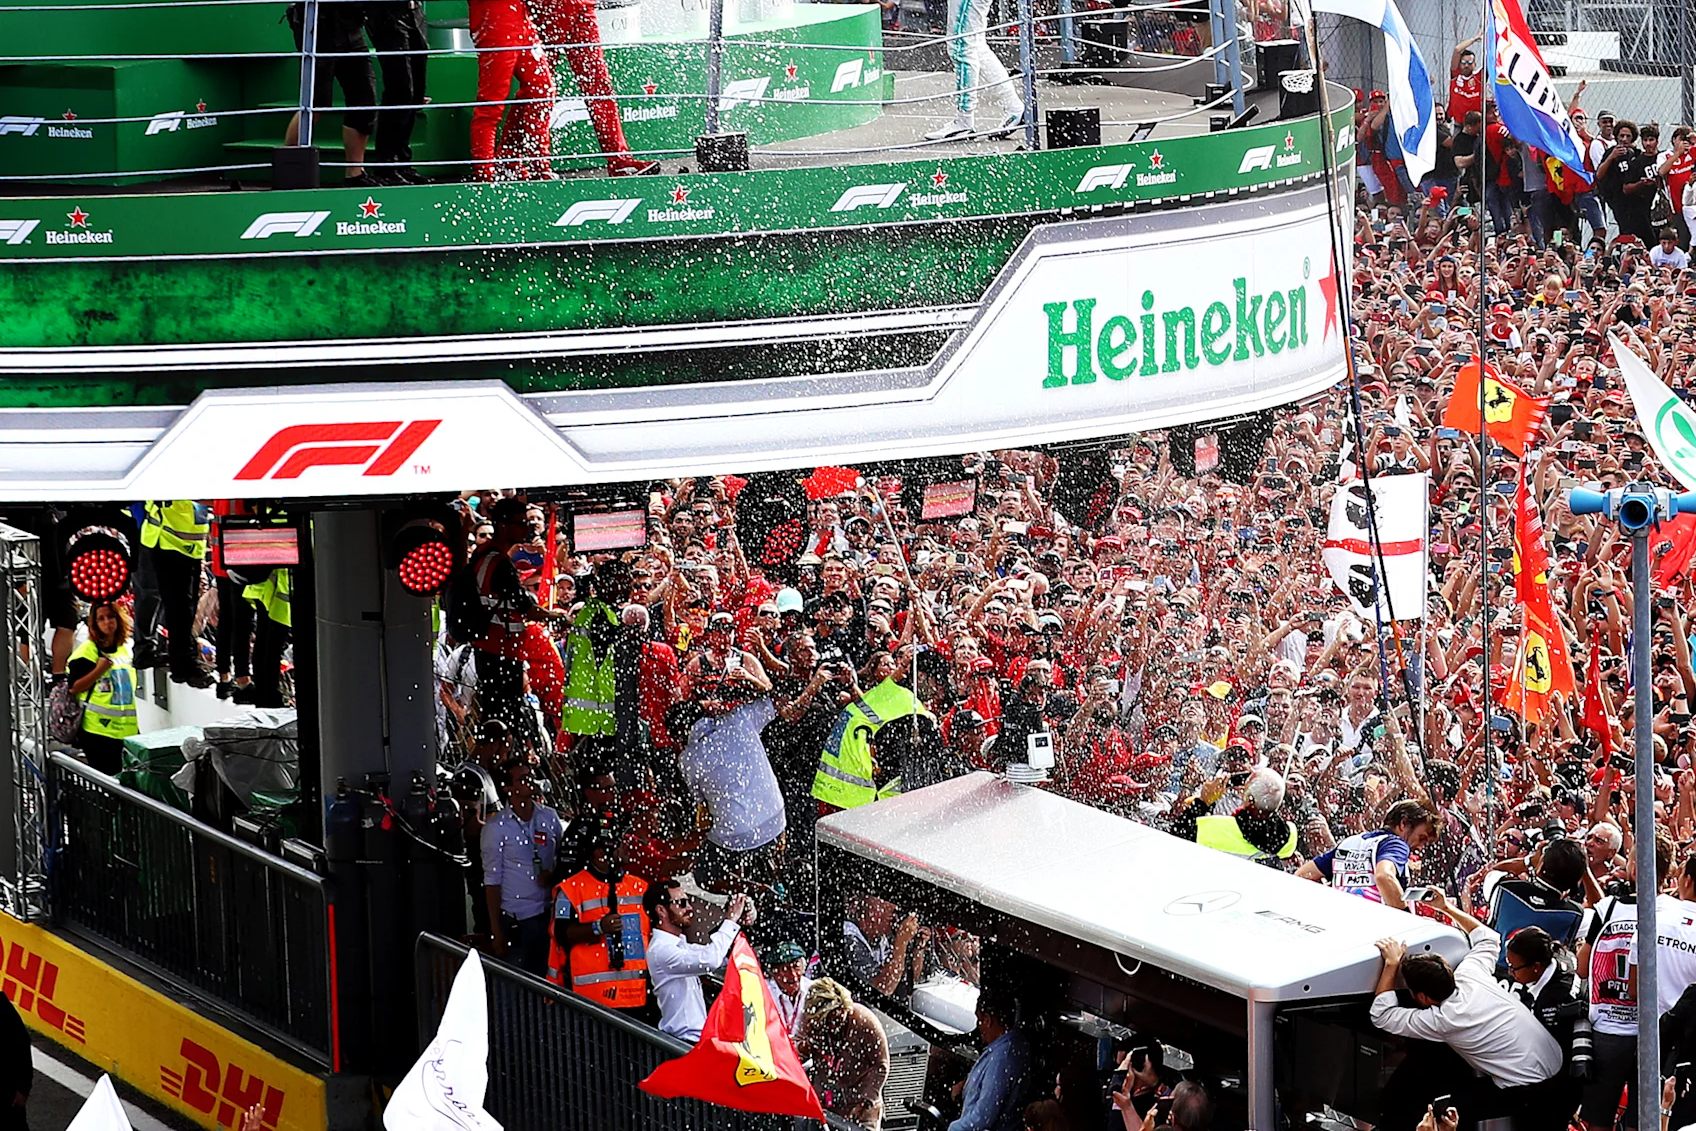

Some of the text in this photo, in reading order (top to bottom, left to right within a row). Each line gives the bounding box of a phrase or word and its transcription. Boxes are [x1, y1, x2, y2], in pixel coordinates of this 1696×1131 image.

[622, 104, 677, 122] Heineken
[48, 126, 94, 139] Heineken
[1136, 170, 1177, 187] Heineken
[909, 190, 970, 208] Heineken
[647, 207, 715, 223] Heineken
[336, 217, 407, 237] Heineken
[45, 228, 114, 246] Heineken
[1042, 277, 1309, 389] Heineken
[232, 419, 443, 481] F1
[413, 466, 431, 475] TM
